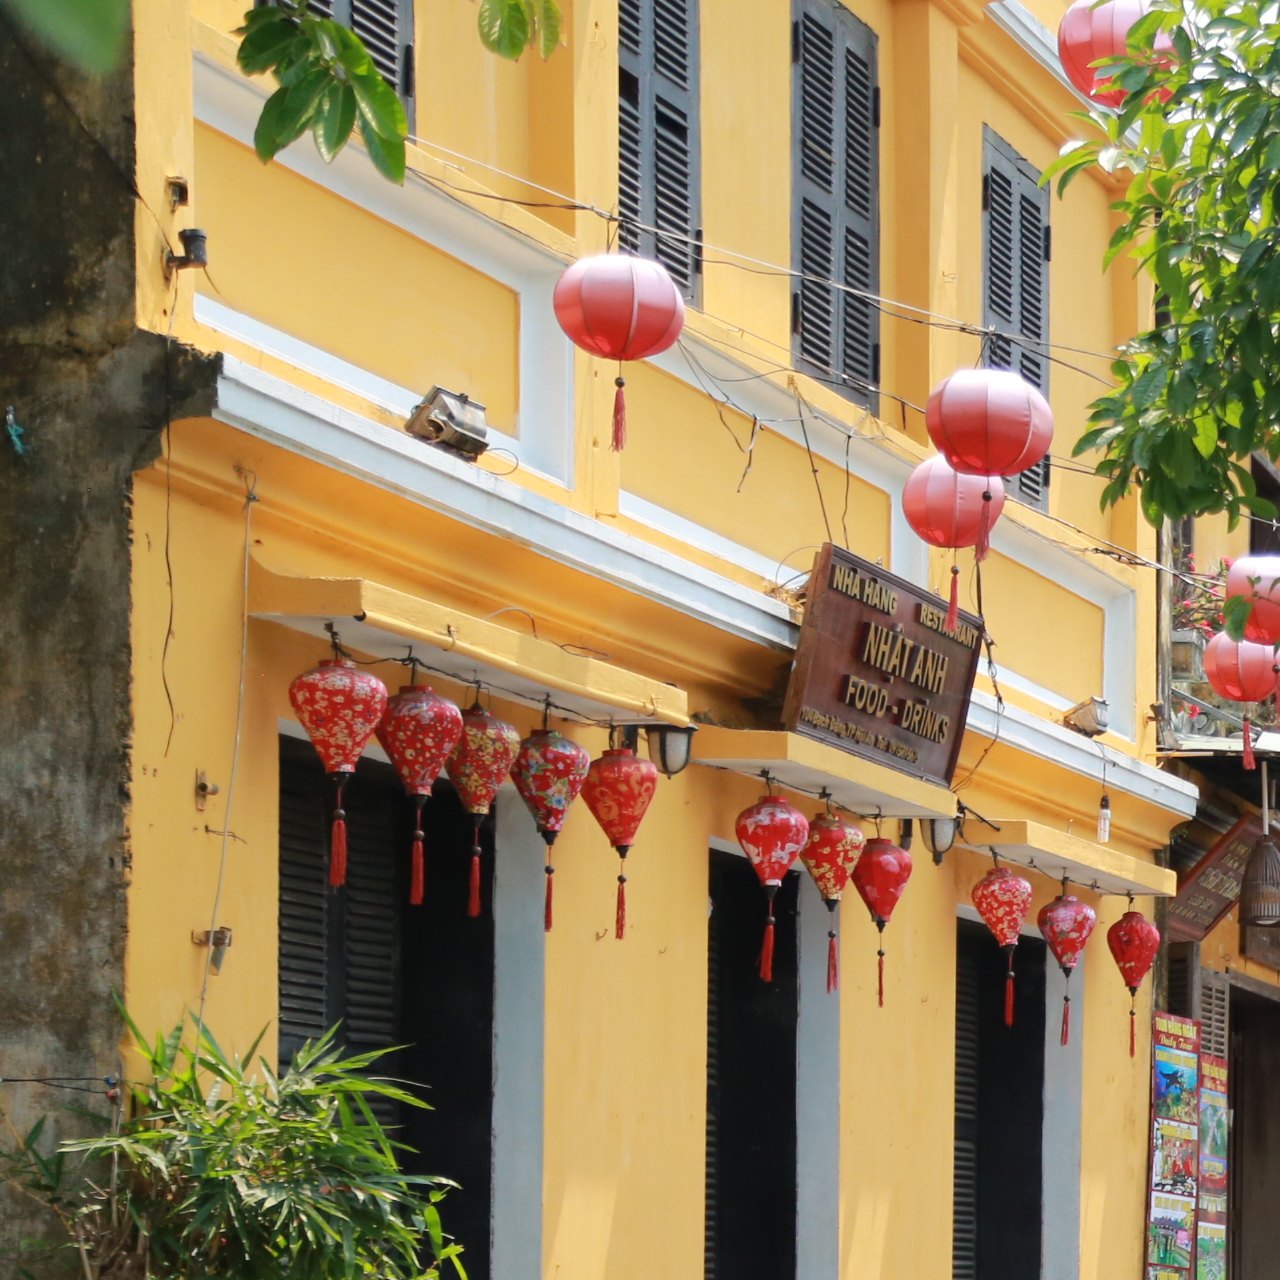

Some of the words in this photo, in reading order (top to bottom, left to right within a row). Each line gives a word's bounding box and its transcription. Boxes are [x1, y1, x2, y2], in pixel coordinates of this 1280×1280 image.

[833, 565, 860, 599] NHÀ
[863, 577, 898, 616] HÀNG
[920, 603, 979, 649] RESTRANT
[910, 645, 949, 695] ANH
[845, 674, 889, 718] FOOD
[901, 698, 950, 744] DRINKS
[1159, 1033, 1177, 1048] Daily
[1178, 1038, 1193, 1050] Tour
